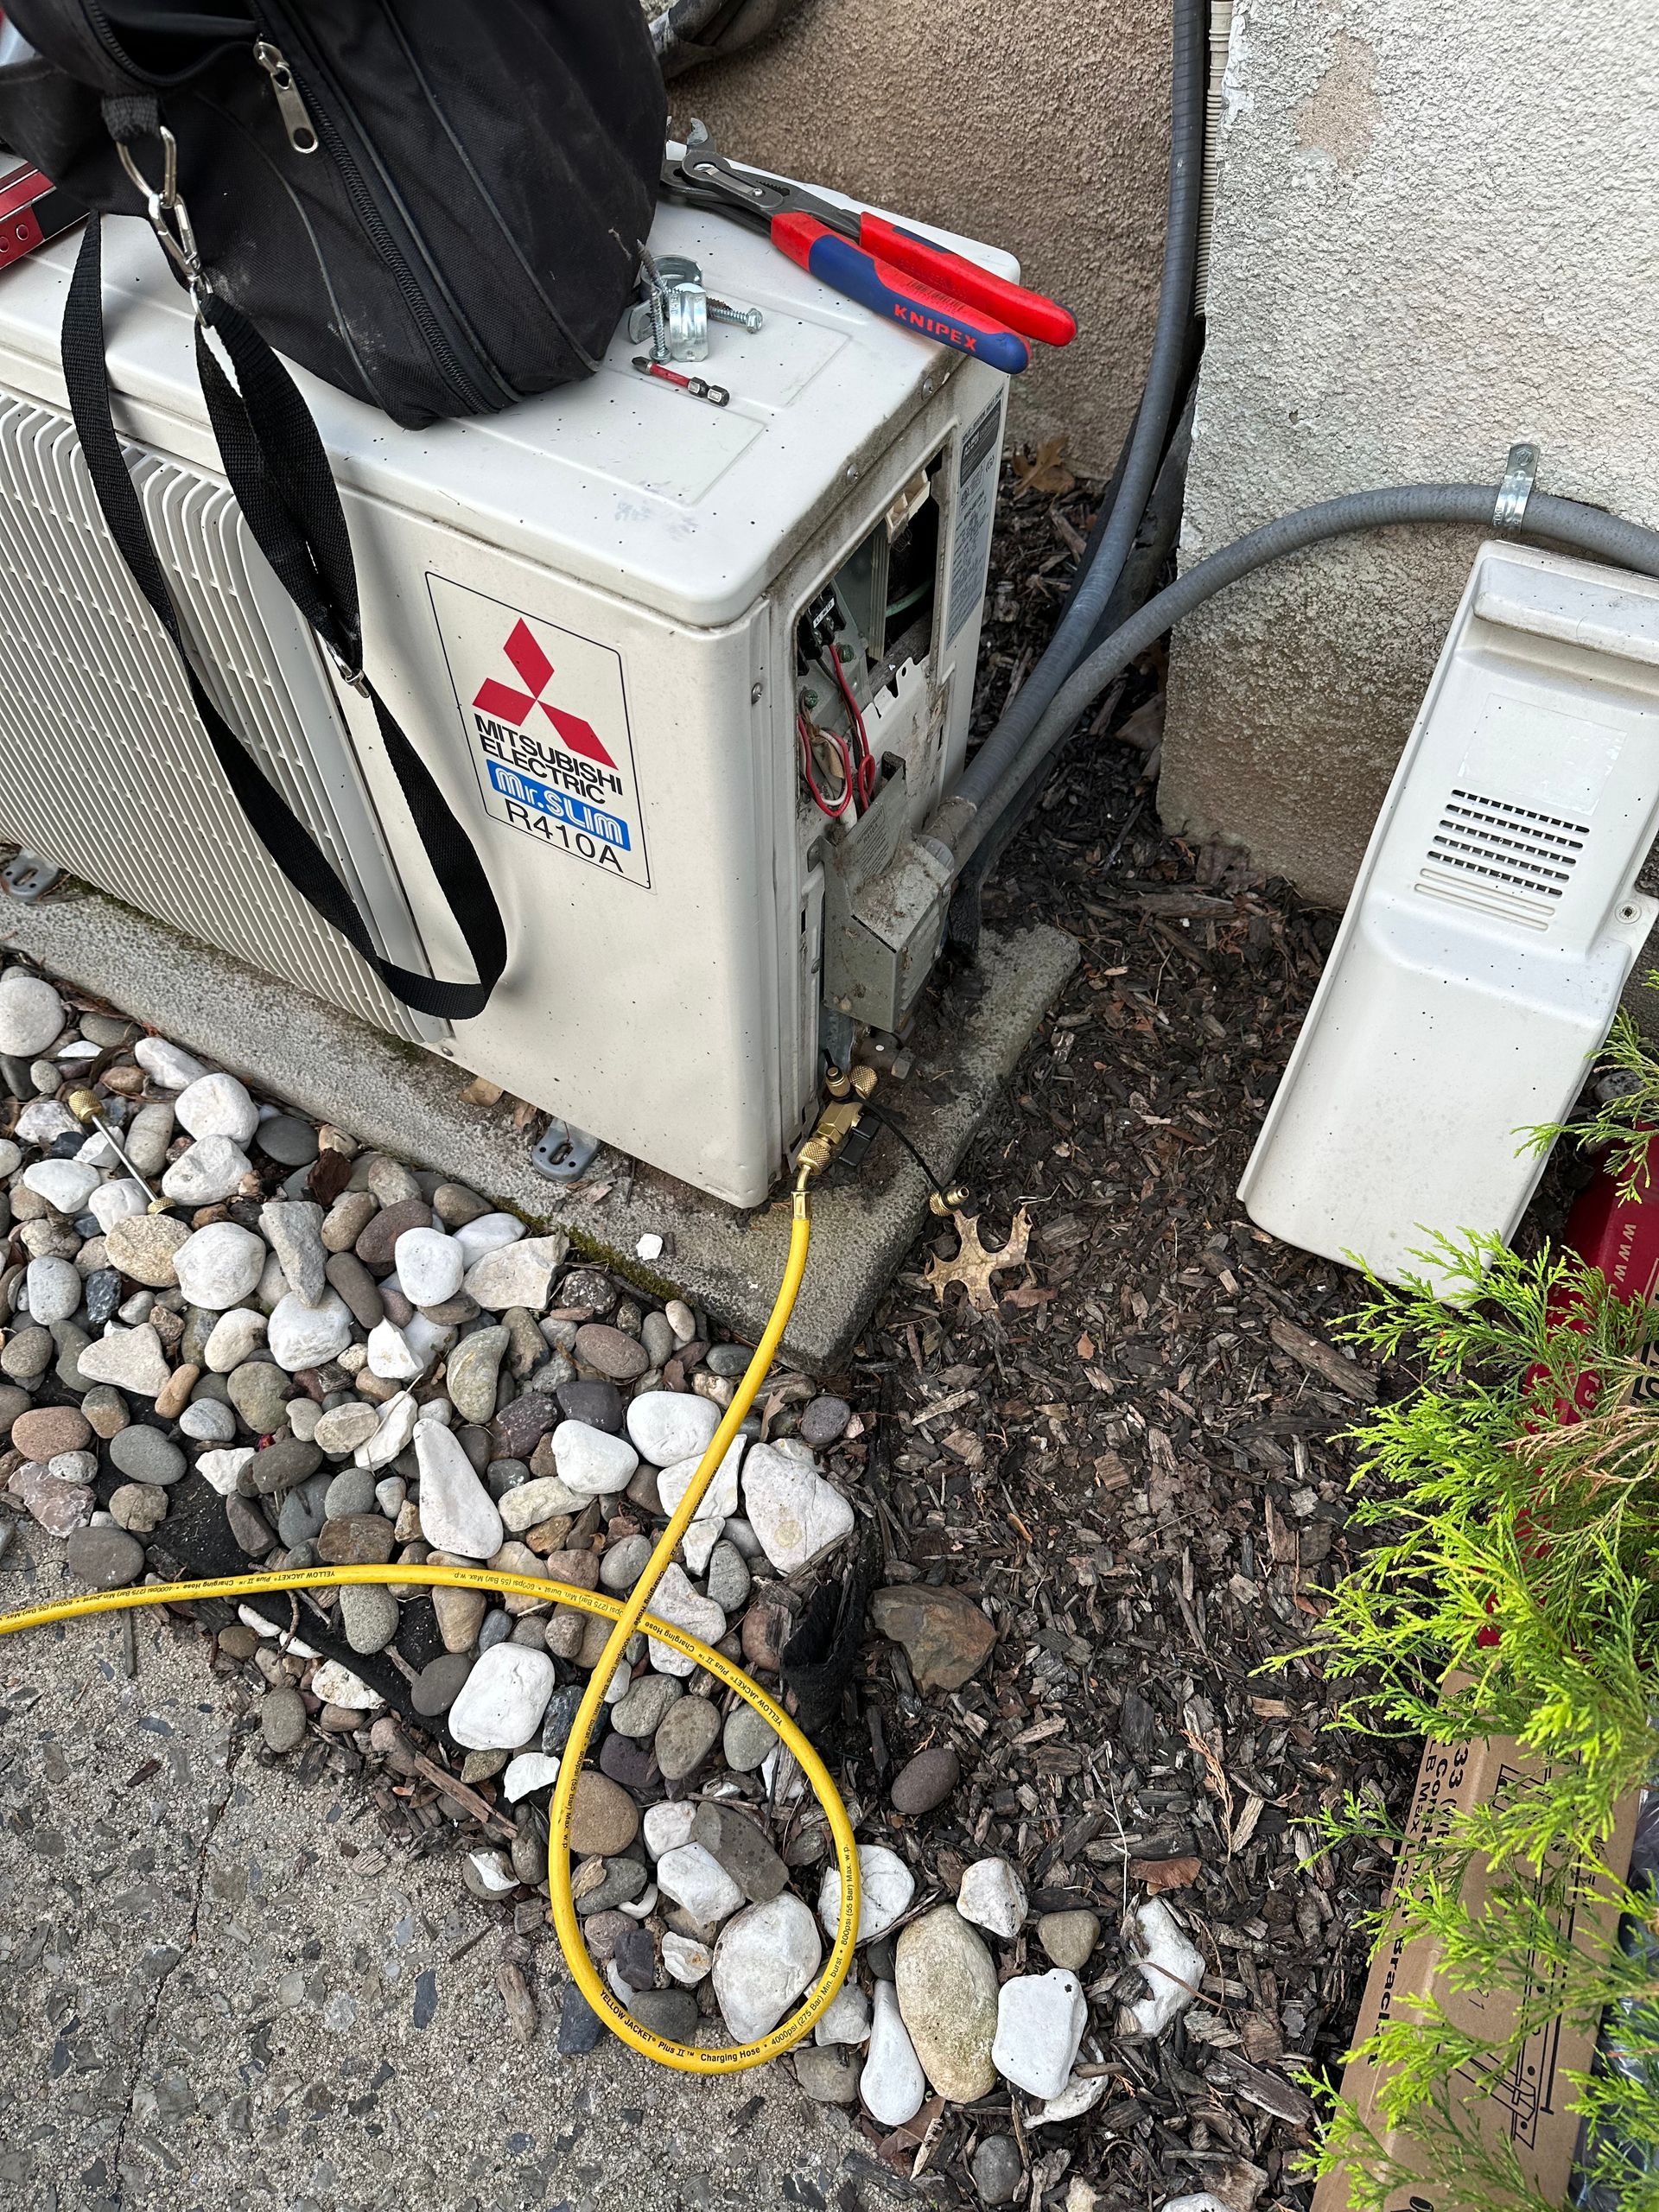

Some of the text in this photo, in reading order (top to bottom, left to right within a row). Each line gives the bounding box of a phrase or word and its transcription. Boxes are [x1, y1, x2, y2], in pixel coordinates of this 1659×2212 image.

[894, 303, 977, 352] KNIPEX
[474, 713, 624, 797] MITSUBISHI
[479, 734, 607, 804] ELECTRIC
[505, 798, 624, 874] R410A
[702, 1465, 719, 1495] YELLOW
[202, 1580, 234, 1588] Charging
[306, 1571, 335, 1581] YELLOW
[485, 1576, 499, 1585] Bar)
[147, 1585, 173, 1593] 4000psi
[544, 1586, 563, 1597] burst
[644, 1570, 665, 1604] Charging
[50, 1599, 73, 1609] 800psi
[578, 1595, 593, 1606] Bar)
[594, 1601, 609, 1612] (275
[22, 1607, 36, 1616] Bar)
[633, 1605, 646, 1626] Hose
[645, 1621, 664, 1636] Hose
[664, 1630, 696, 1652] Charging
[714, 1663, 730, 1676] Plus
[757, 1699, 783, 1727] YELLOW
[565, 1793, 575, 1810] Bar)
[1409, 1782, 1431, 1834] Max
[599, 1988, 626, 2020] YELLOW
[658, 2040, 675, 2054] Plus
[701, 2053, 738, 2063] Charging
[739, 2047, 760, 2059] Hose
[771, 2024, 798, 2046] 4000psi
[797, 2009, 812, 2027] (275
[810, 1995, 824, 2012] Bar)
[820, 1980, 834, 1995] Min.
[830, 1956, 842, 1978] burst
[841, 1918, 851, 1946] 800psi
[846, 1884, 855, 1901] Bar)
